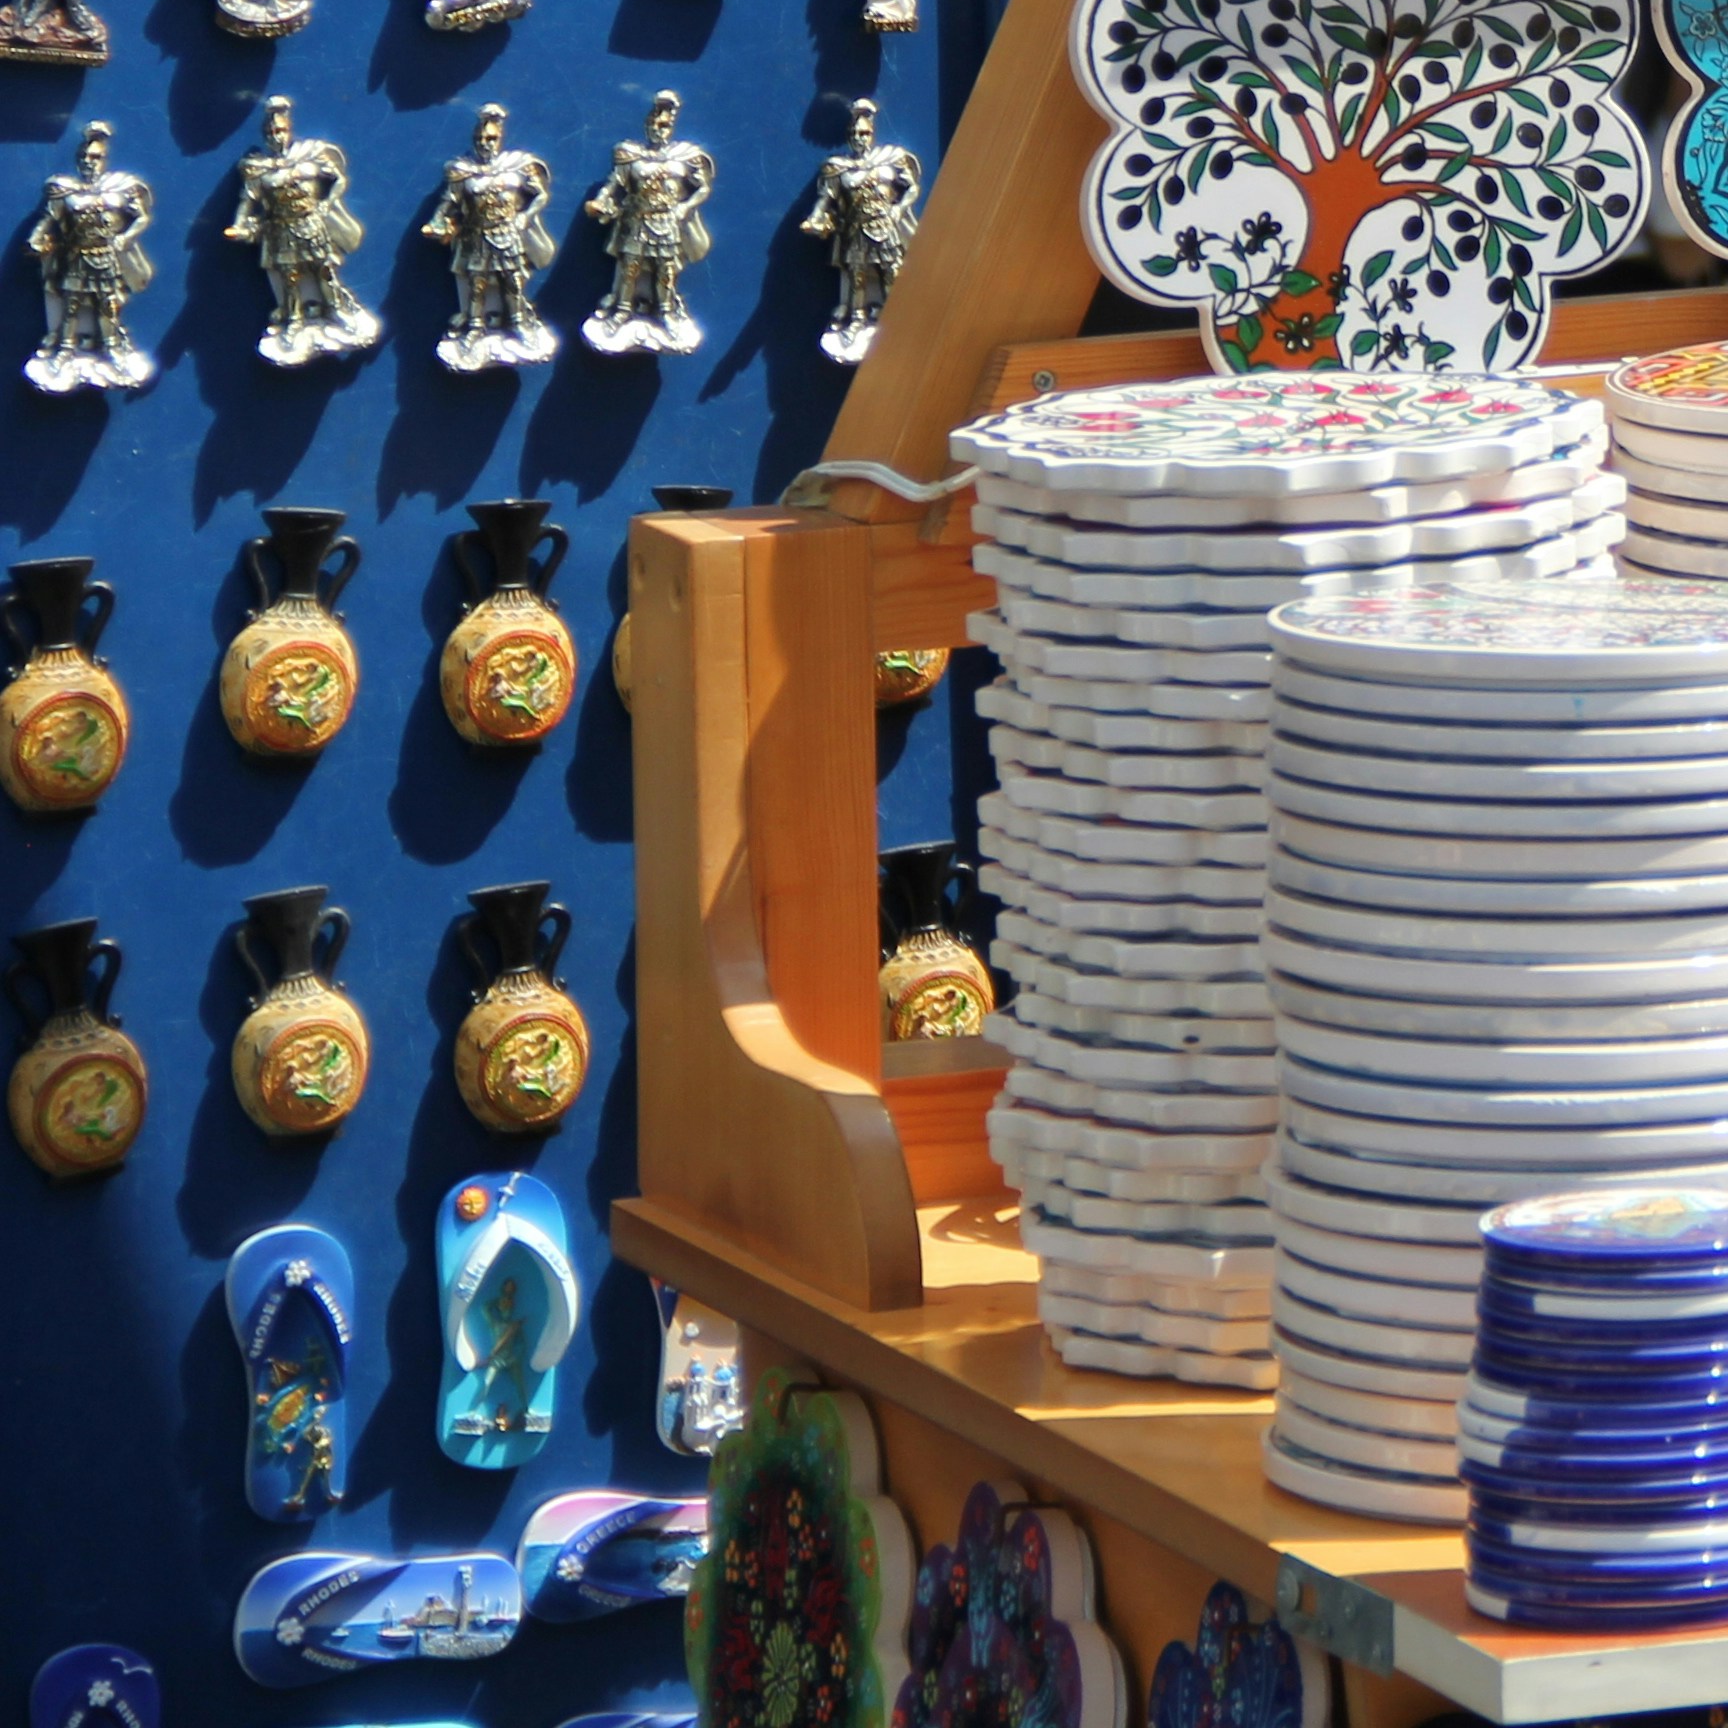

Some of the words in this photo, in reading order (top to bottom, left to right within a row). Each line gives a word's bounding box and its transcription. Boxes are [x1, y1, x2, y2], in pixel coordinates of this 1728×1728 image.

[250, 1293, 282, 1359] RHODES
[314, 1283, 350, 1345] RHODES
[575, 1510, 638, 1554] GREECE
[298, 1570, 361, 1617] RHODES
[301, 1647, 358, 1671] RHODES
